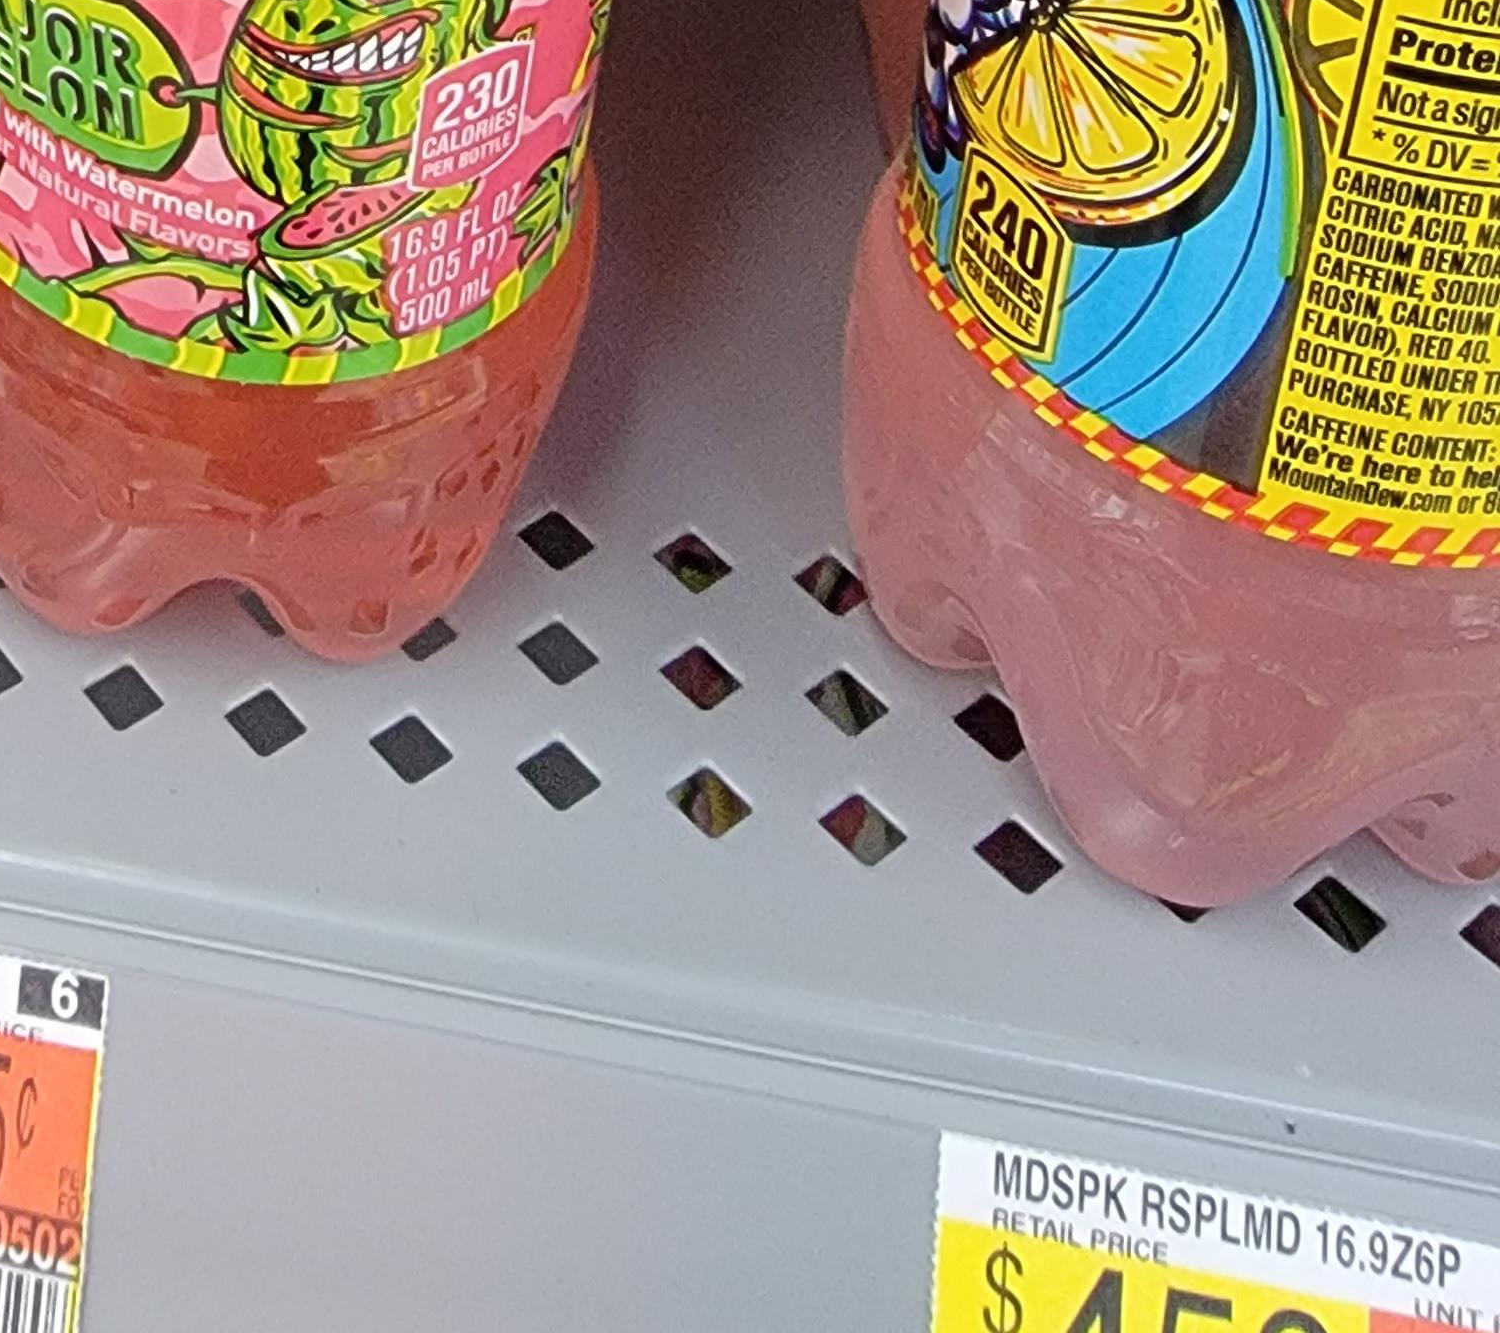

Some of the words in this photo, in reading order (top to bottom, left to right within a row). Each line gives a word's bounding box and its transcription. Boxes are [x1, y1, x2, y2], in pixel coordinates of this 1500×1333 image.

[431, 58, 520, 134] 230
[1375, 80, 1428, 120] Not
[1426, 98, 1450, 123] a
[1452, 97, 1500, 136] sig
[420, 102, 519, 161] CALORIES
[420, 155, 456, 183] PER
[457, 130, 512, 170] BOTTLE
[1392, 134, 1420, 164] %
[4, 106, 57, 162] with
[60, 146, 256, 230] Watermelon
[1332, 166, 1483, 219] CARBONATED
[18, 149, 121, 228] Natural
[128, 207, 250, 259] Flavors
[390, 218, 448, 264] 16.9
[456, 204, 481, 244] FL
[491, 181, 522, 218] OZ
[969, 169, 1049, 281] 240
[1325, 195, 1406, 236] CITRIC
[1408, 213, 1469, 250] ACID,
[388, 248, 462, 306] (1.05
[469, 224, 508, 271] PT)
[961, 217, 1044, 315] CALORIES
[1319, 223, 1416, 269] SODIUM
[398, 287, 453, 334] 500
[459, 266, 492, 310] mL
[959, 246, 984, 289] PER
[983, 273, 1037, 338] BOTTLE
[1313, 251, 1427, 302] CAFFEINE,
[1301, 308, 1401, 357] FLAVOR),
[1408, 332, 1455, 361] RED
[1457, 339, 1492, 365] 40.
[1306, 280, 1384, 324] ROSIN,
[1390, 301, 1494, 337] CALCIUM
[1294, 337, 1397, 384] BOTTLED
[1400, 361, 1479, 394] UNDER
[1287, 368, 1412, 421] PURCHASE,
[1419, 396, 1452, 423] NY
[1275, 431, 1355, 474] We're
[1362, 454, 1423, 489] here
[1428, 463, 1455, 490] to
[1279, 405, 1389, 453] CAFFEINE
[1391, 431, 1498, 464] CONTENT:
[1268, 456, 1452, 515] MountainDew.com
[1457, 493, 1480, 514] or
[50, 969, 82, 1020] 6
[992, 1206, 1081, 1249] RETAIL
[1089, 1227, 1169, 1268] PRICE
[993, 1150, 1129, 1223] MDSPK
[1140, 1183, 1302, 1257] RSPLMD
[1315, 1219, 1462, 1288] 16.9Z6P
[1413, 1296, 1485, 1332] UNIT
